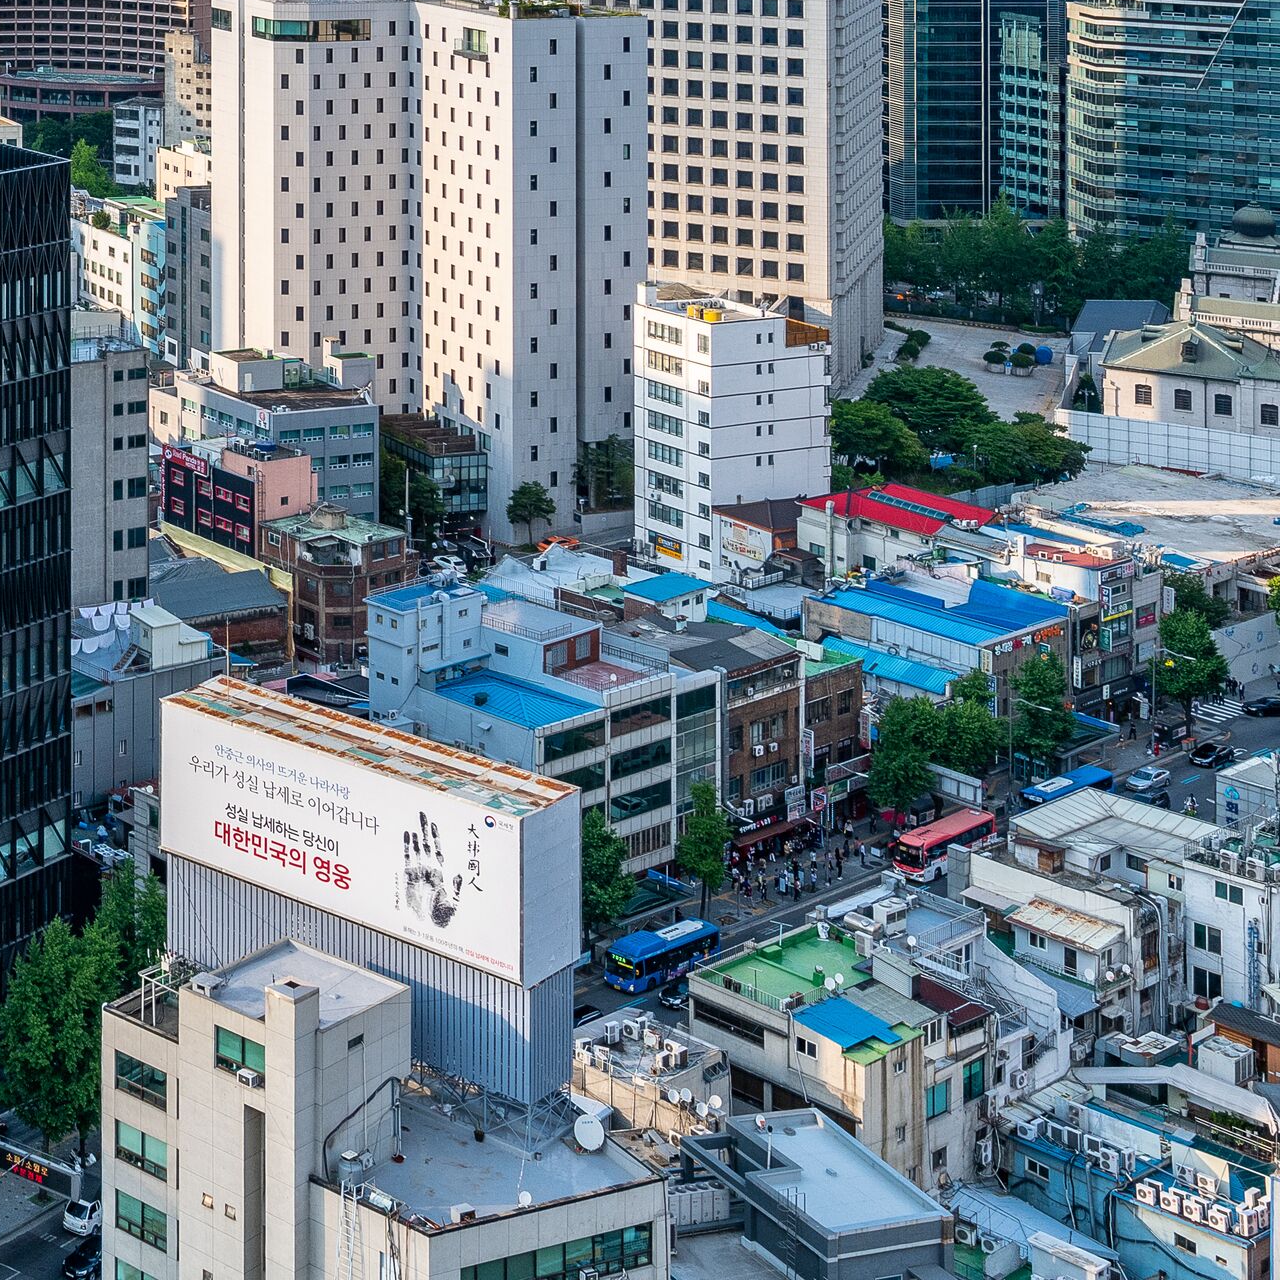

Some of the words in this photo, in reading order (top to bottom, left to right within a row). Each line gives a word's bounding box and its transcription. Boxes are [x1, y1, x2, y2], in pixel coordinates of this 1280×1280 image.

[182, 452, 197, 465] Panda
[189, 755, 229, 783] 우리가
[233, 770, 259, 794] 성실
[262, 781, 304, 808] 납세로
[308, 797, 380, 835] 이어갑니다
[214, 744, 244, 764] 안중근
[246, 754, 275, 775] 의사의
[277, 765, 308, 785] 뜨거운
[309, 776, 351, 800] 나라사랑
[214, 820, 307, 875] 대한민국의
[313, 855, 352, 890] 영웅
[225, 802, 248, 824] 성실
[251, 811, 300, 842] 납세하는
[302, 830, 340, 857] 당신이
[465, 949, 475, 958] 성실
[475, 952, 490, 963] 납세에
[490, 957, 515, 971] 감사합니다
